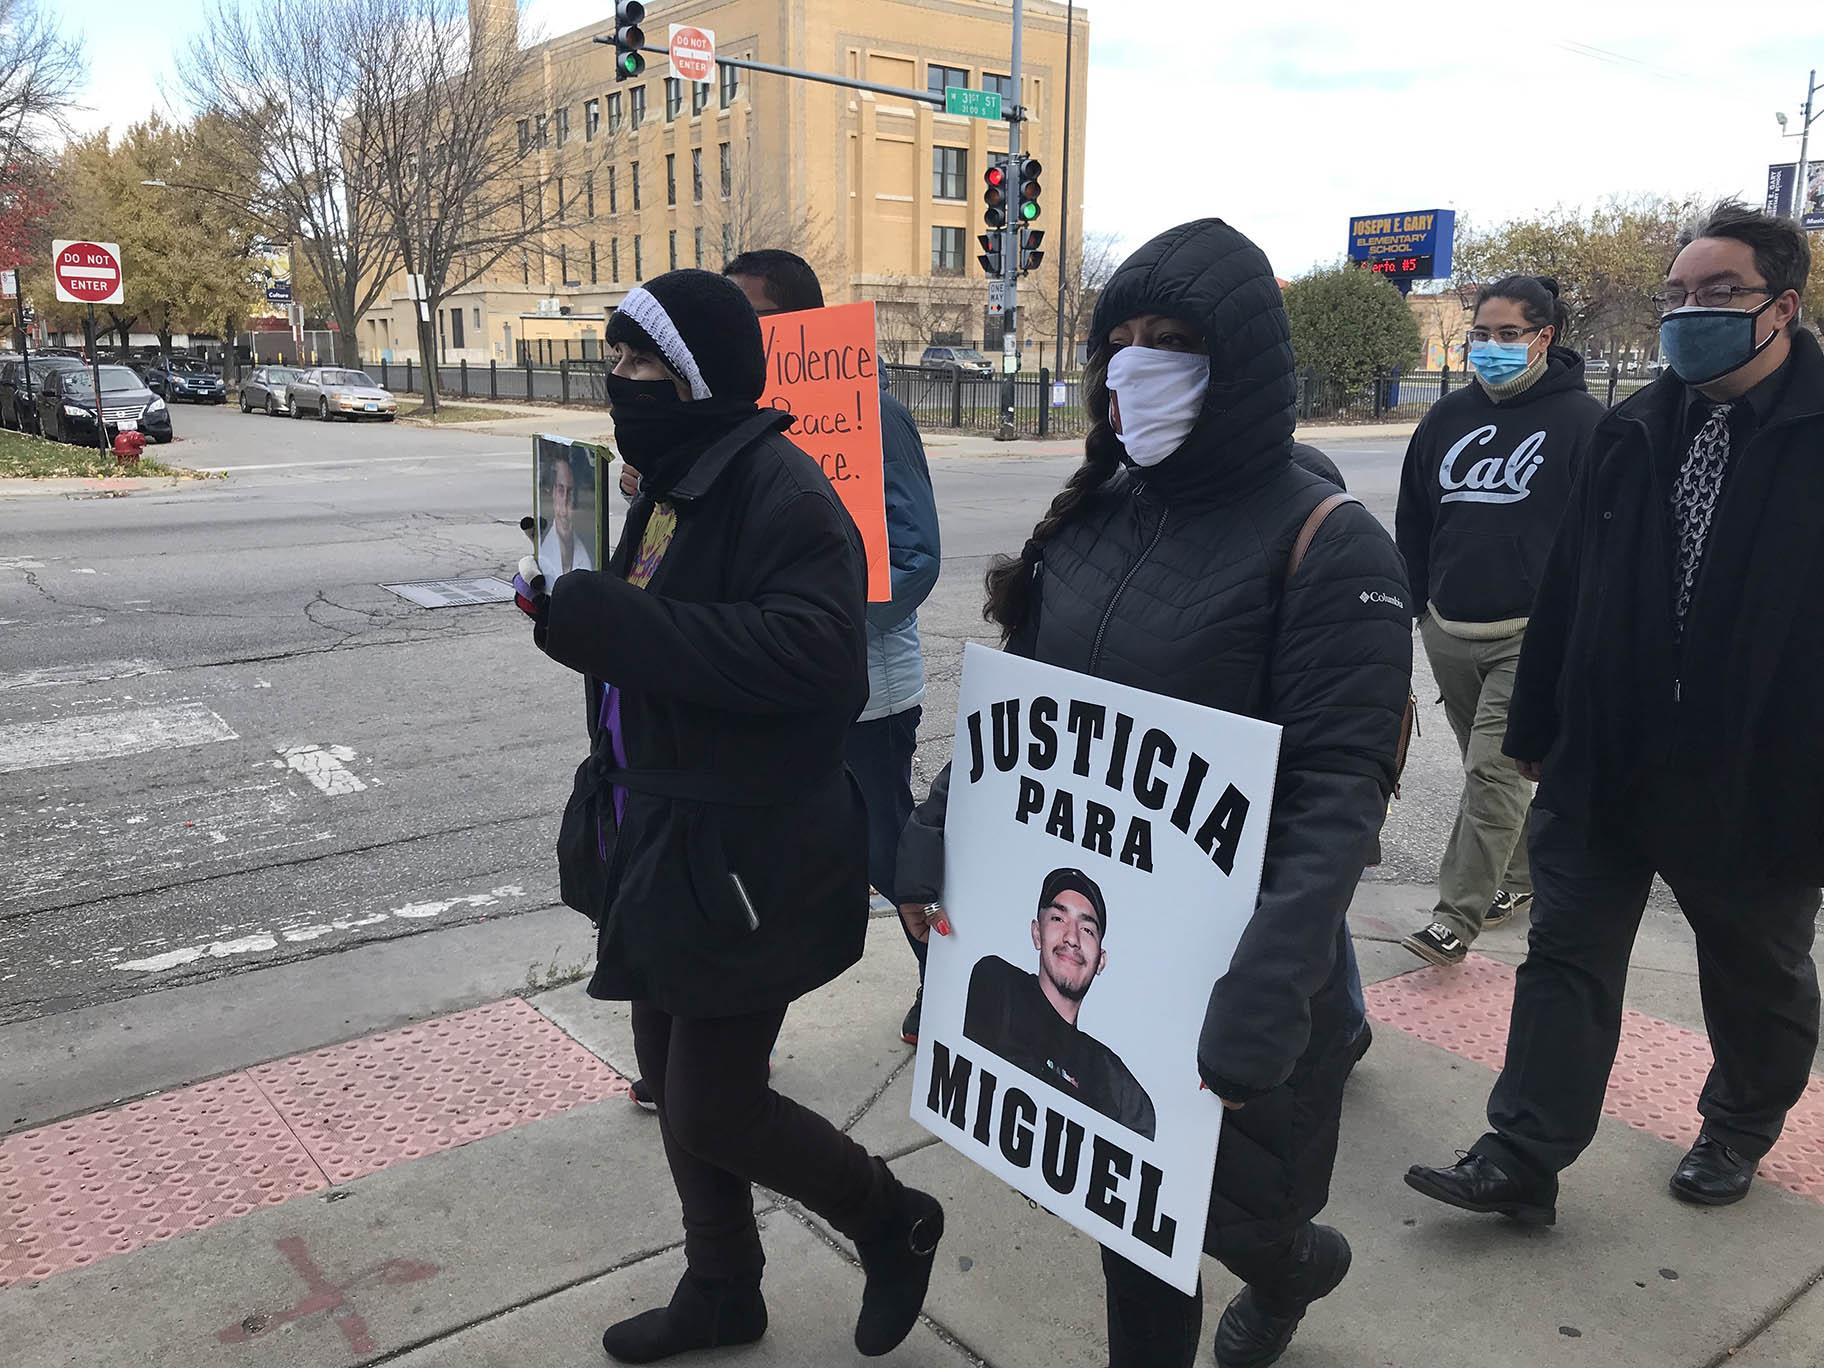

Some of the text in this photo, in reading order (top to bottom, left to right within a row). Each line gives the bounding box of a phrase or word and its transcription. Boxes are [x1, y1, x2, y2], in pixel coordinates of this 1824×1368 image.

[676, 35, 707, 48] DO NOT
[679, 60, 706, 71] ENTER
[984, 96, 996, 108] ST
[1352, 214, 1434, 236] JOSEPH E. GARY
[1356, 233, 1427, 247] ELEMENTARY
[1368, 243, 1413, 255] SCHOOL
[64, 253, 110, 265] DO NOT
[1401, 258, 1417, 271] #5
[70, 279, 108, 291] ENTER
[990, 283, 1004, 293] ONE
[1438, 424, 1547, 503] Cali
[966, 695, 1251, 878] JUSTICIA
[1015, 774, 1154, 874] PARA
[926, 1039, 1177, 1258] MIGUEL
